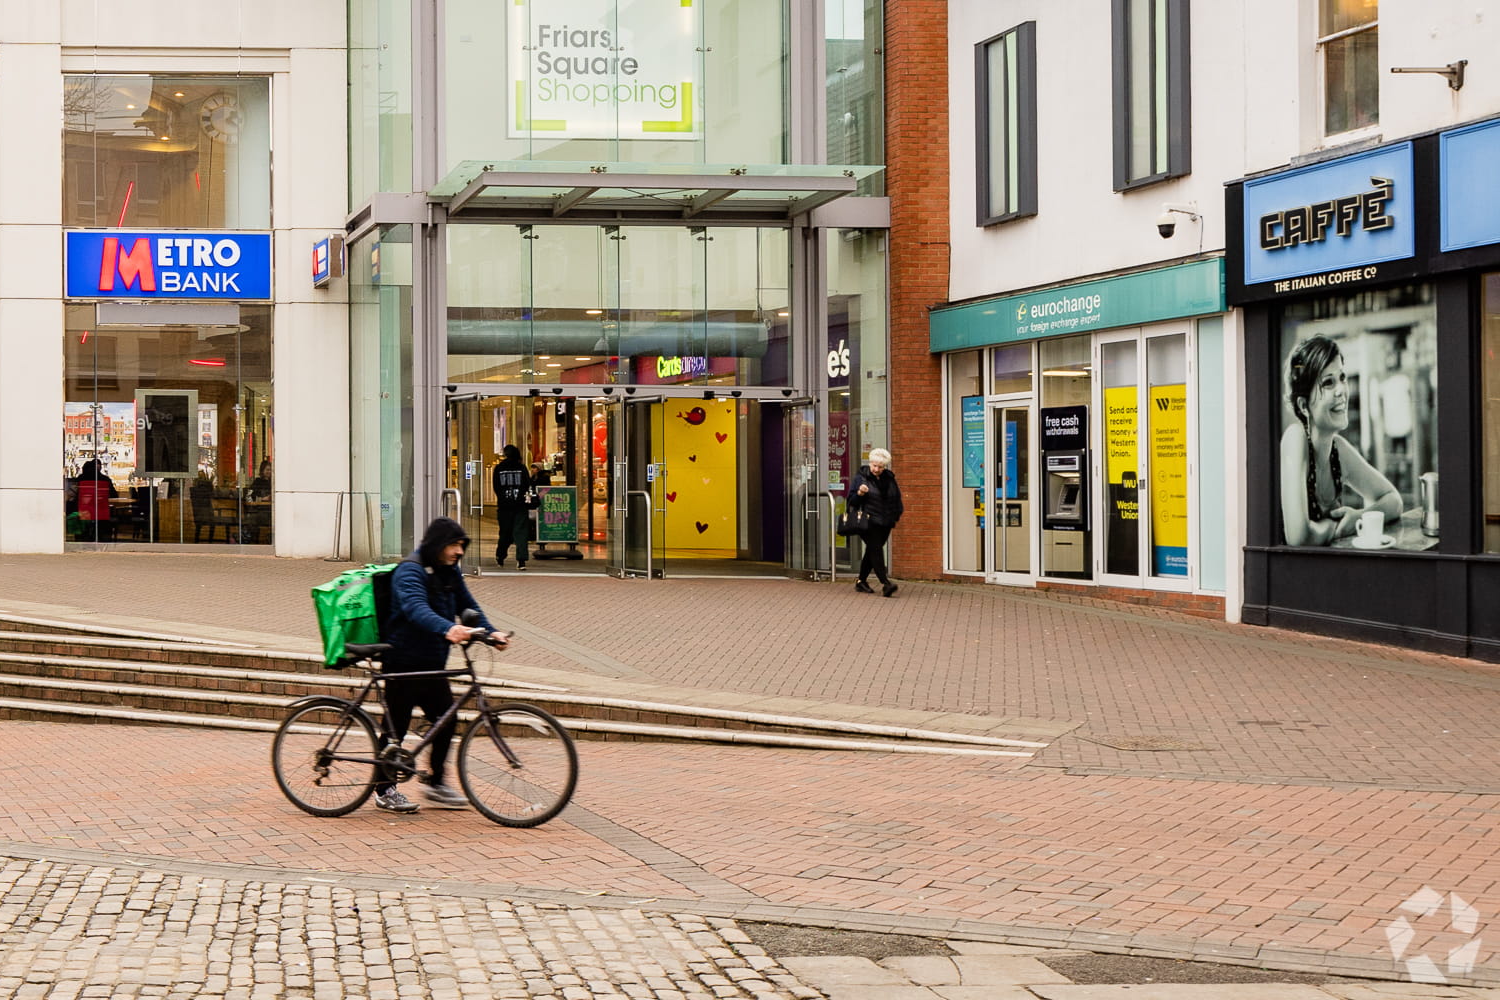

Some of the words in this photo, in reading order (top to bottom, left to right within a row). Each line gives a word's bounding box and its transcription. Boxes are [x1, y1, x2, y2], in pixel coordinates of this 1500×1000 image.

[538, 25, 611, 48] Friars
[537, 51, 638, 80] Square
[537, 78, 677, 109] Shopping
[1260, 176, 1394, 250] CAFFÈ
[98, 237, 241, 291] METRO
[161, 271, 241, 292] BANK
[1274, 282, 1290, 293] THE
[1291, 275, 1326, 290] ITALIAN
[1328, 269, 1362, 285] COFFEE
[1030, 294, 1101, 318] eurochange
[1016, 325, 1029, 336] your
[1030, 321, 1050, 333] foreign
[1050, 317, 1079, 328] exchange
[1080, 313, 1100, 325] expert
[1045, 416, 1060, 427] free
[1061, 414, 1079, 426] cash
[1109, 406, 1124, 414] Send
[841, 424, 847, 437] 3
[1045, 427, 1079, 436] withdrawals
[1111, 439, 1136, 447] Western
[1111, 449, 1131, 457] Union.
[544, 503, 570, 512] SAUR
[544, 511, 571, 524] DAY
